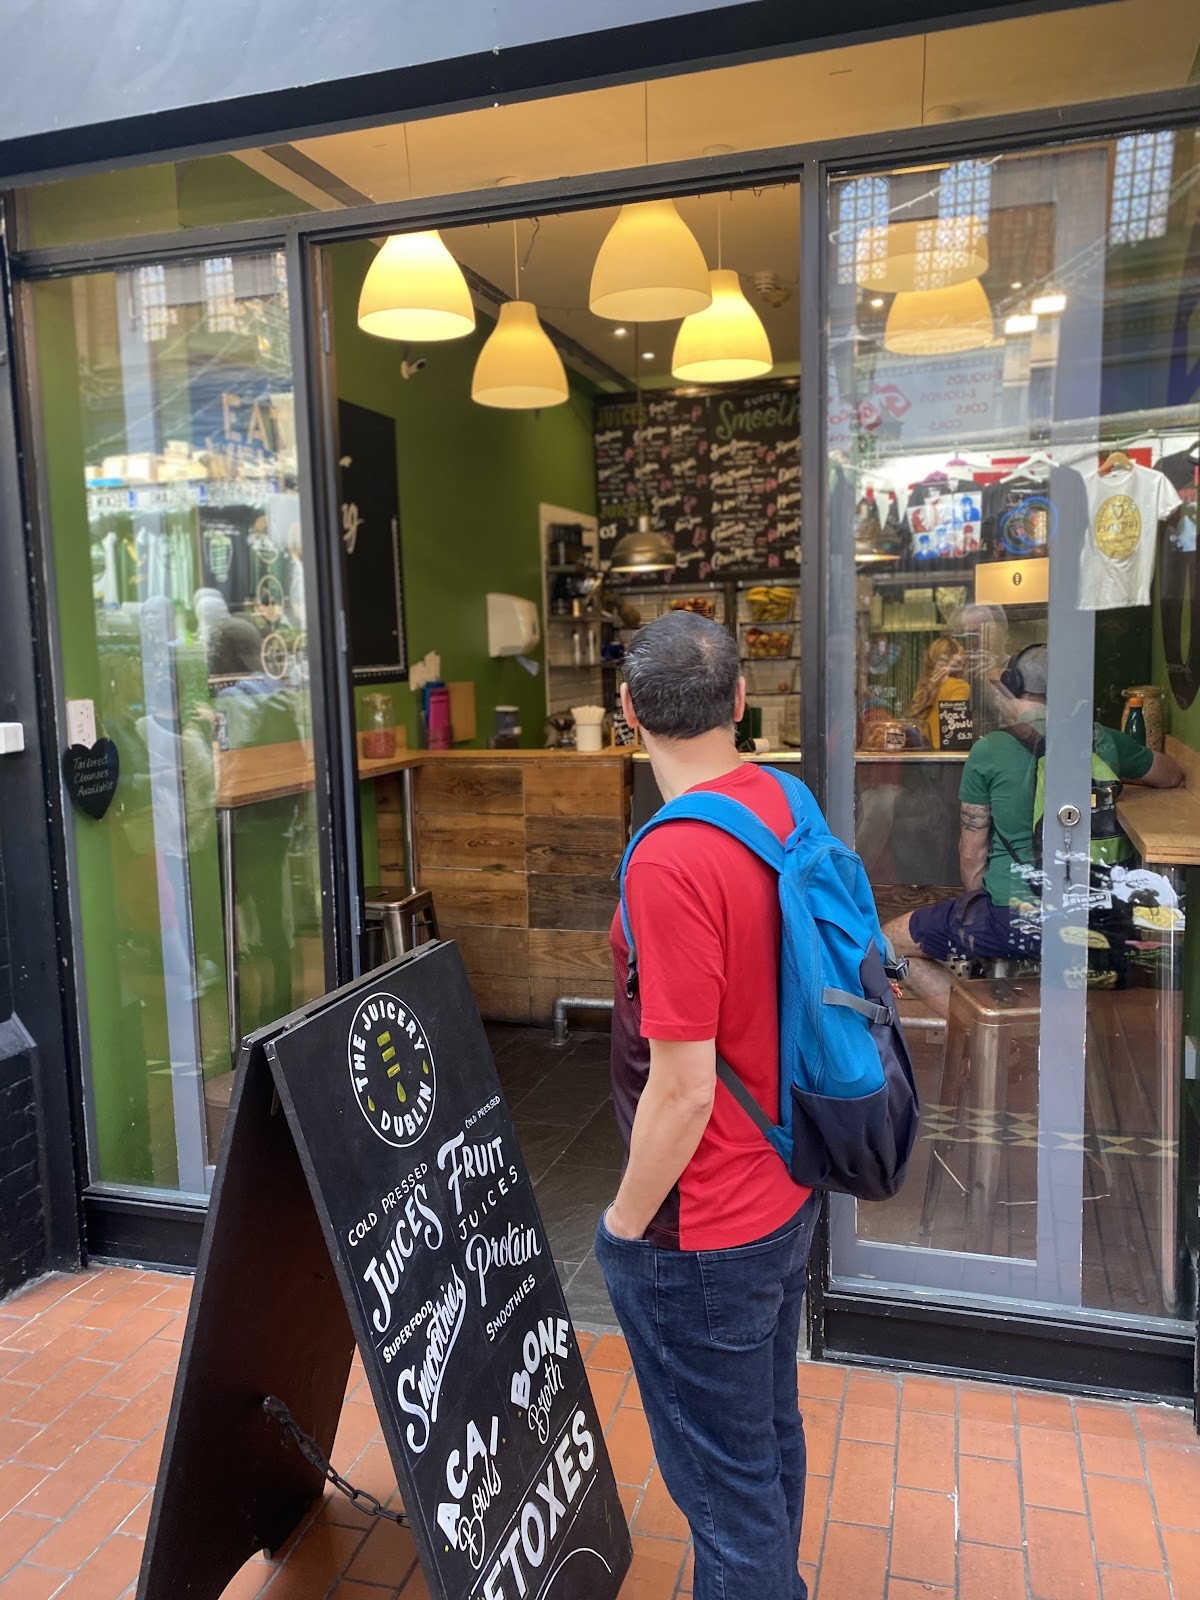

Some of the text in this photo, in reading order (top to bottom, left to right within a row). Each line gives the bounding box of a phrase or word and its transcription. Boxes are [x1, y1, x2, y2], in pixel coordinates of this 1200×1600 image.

[744, 392, 780, 408] SUPER
[72, 754, 108, 770] Tailored
[74, 769, 109, 784] Cleanses
[77, 781, 114, 797] Available
[353, 1000, 425, 1093] THE JUICERY
[380, 1080, 432, 1138] DUBLIN
[464, 1096, 501, 1129] COLD PRESSED
[348, 1163, 428, 1247] COLD PRESSED
[437, 1131, 504, 1215] FRUIT
[458, 1165, 518, 1240] JUICES
[363, 1183, 443, 1333] JUICES
[465, 1221, 542, 1308] Protein
[382, 1300, 433, 1364] SUPERFOOD
[486, 1273, 536, 1342] SMOOTHIES
[396, 1263, 467, 1454] Smoothies
[511, 1316, 569, 1410] BONE
[437, 1415, 498, 1550] ACAI
[458, 1453, 501, 1571] Bowls
